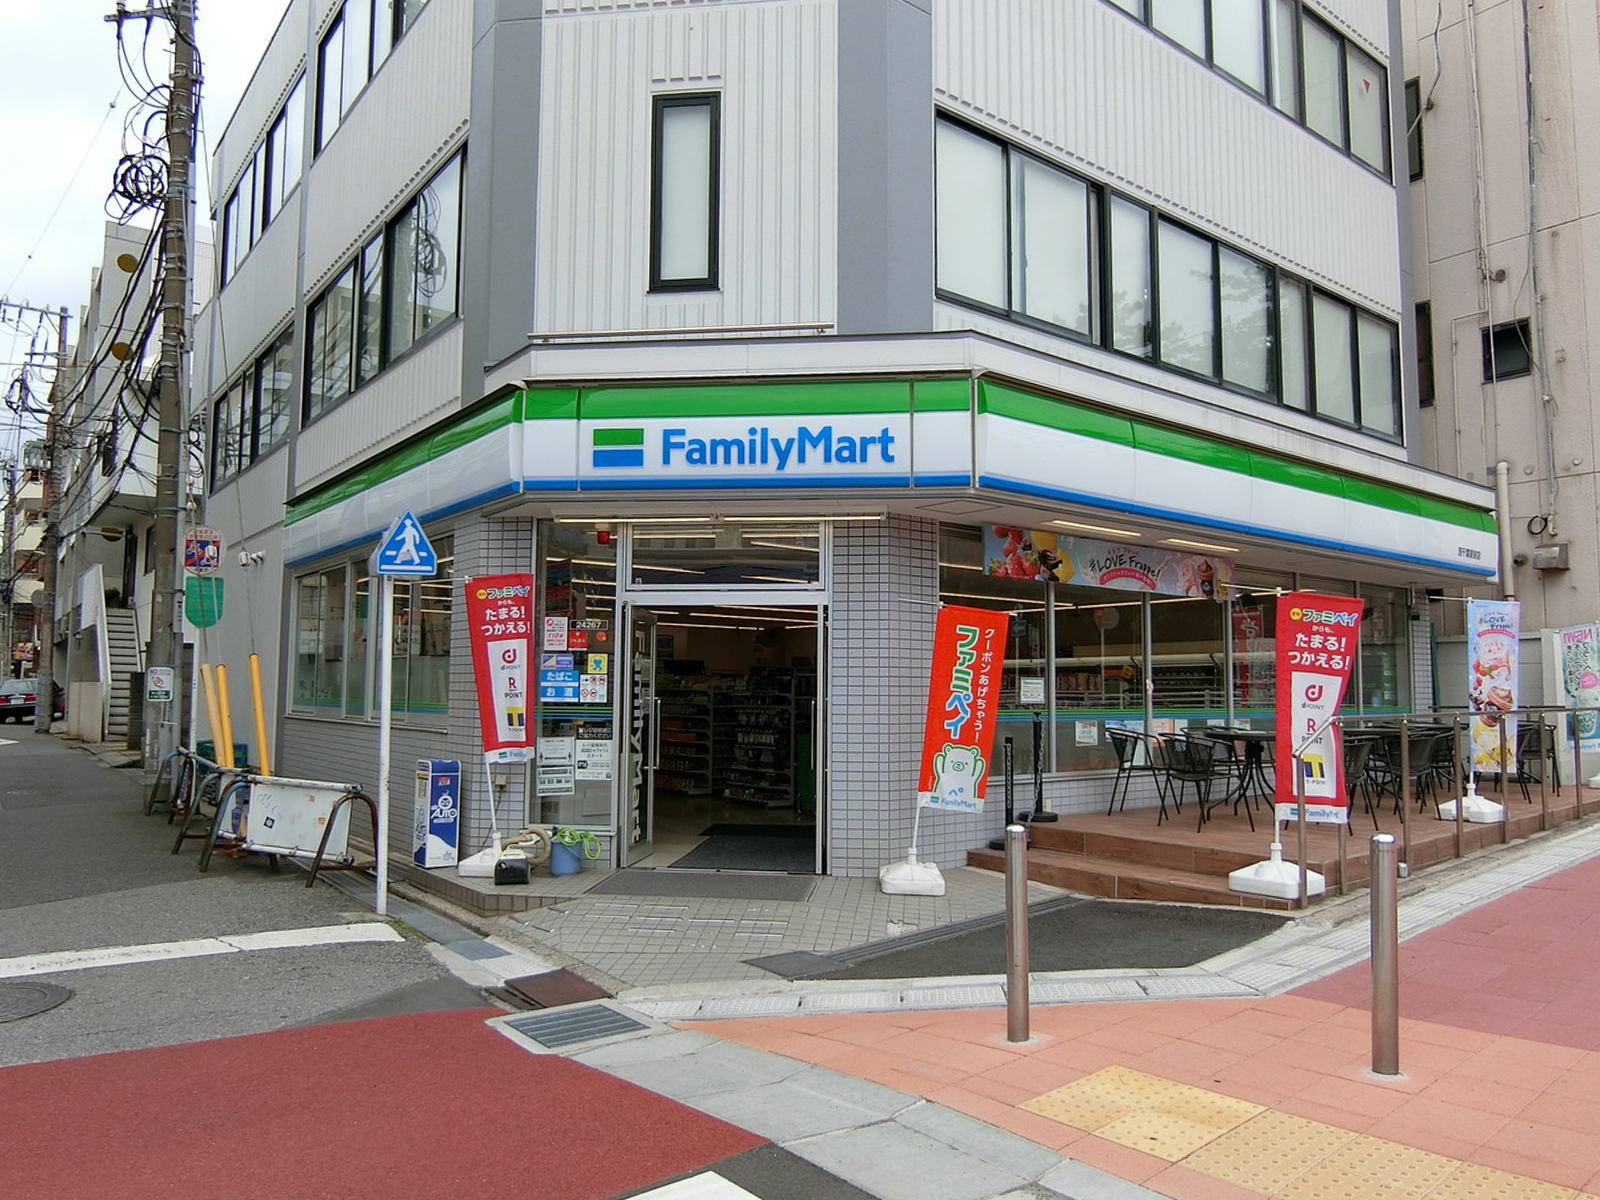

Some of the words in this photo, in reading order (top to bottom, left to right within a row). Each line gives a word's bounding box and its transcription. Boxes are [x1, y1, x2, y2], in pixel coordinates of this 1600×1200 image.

[662, 426, 895, 471] FamilyMart
[487, 585, 530, 599] ファミペイ
[1303, 608, 1358, 627] ファミペイ
[547, 671, 573, 681] たばこ
[945, 624, 979, 739] ファミペイ
[974, 628, 995, 743] クーポンあげちゃう!
[941, 798, 976, 808] FamilyMart
